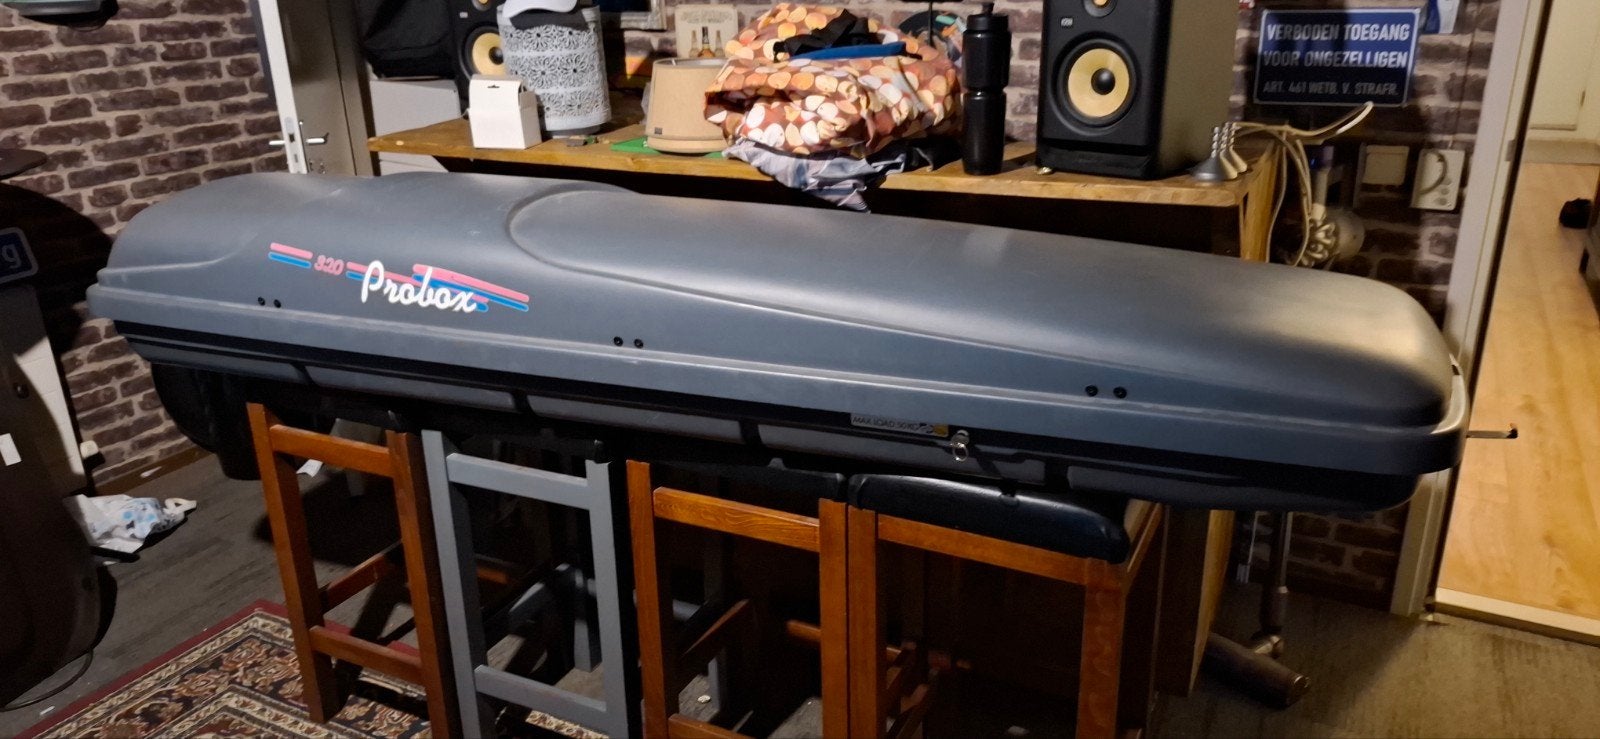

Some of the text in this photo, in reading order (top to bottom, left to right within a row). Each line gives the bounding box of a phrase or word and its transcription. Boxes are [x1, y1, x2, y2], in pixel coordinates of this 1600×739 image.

[1267, 23, 1410, 41] VERBODEN TOEGANG
[1262, 50, 1408, 68] VOOR ONGEZELLIGEN
[1263, 81, 1285, 93] ART.
[1288, 81, 1307, 93] 461
[314, 254, 344, 275] 320
[361, 260, 477, 313] Probox
